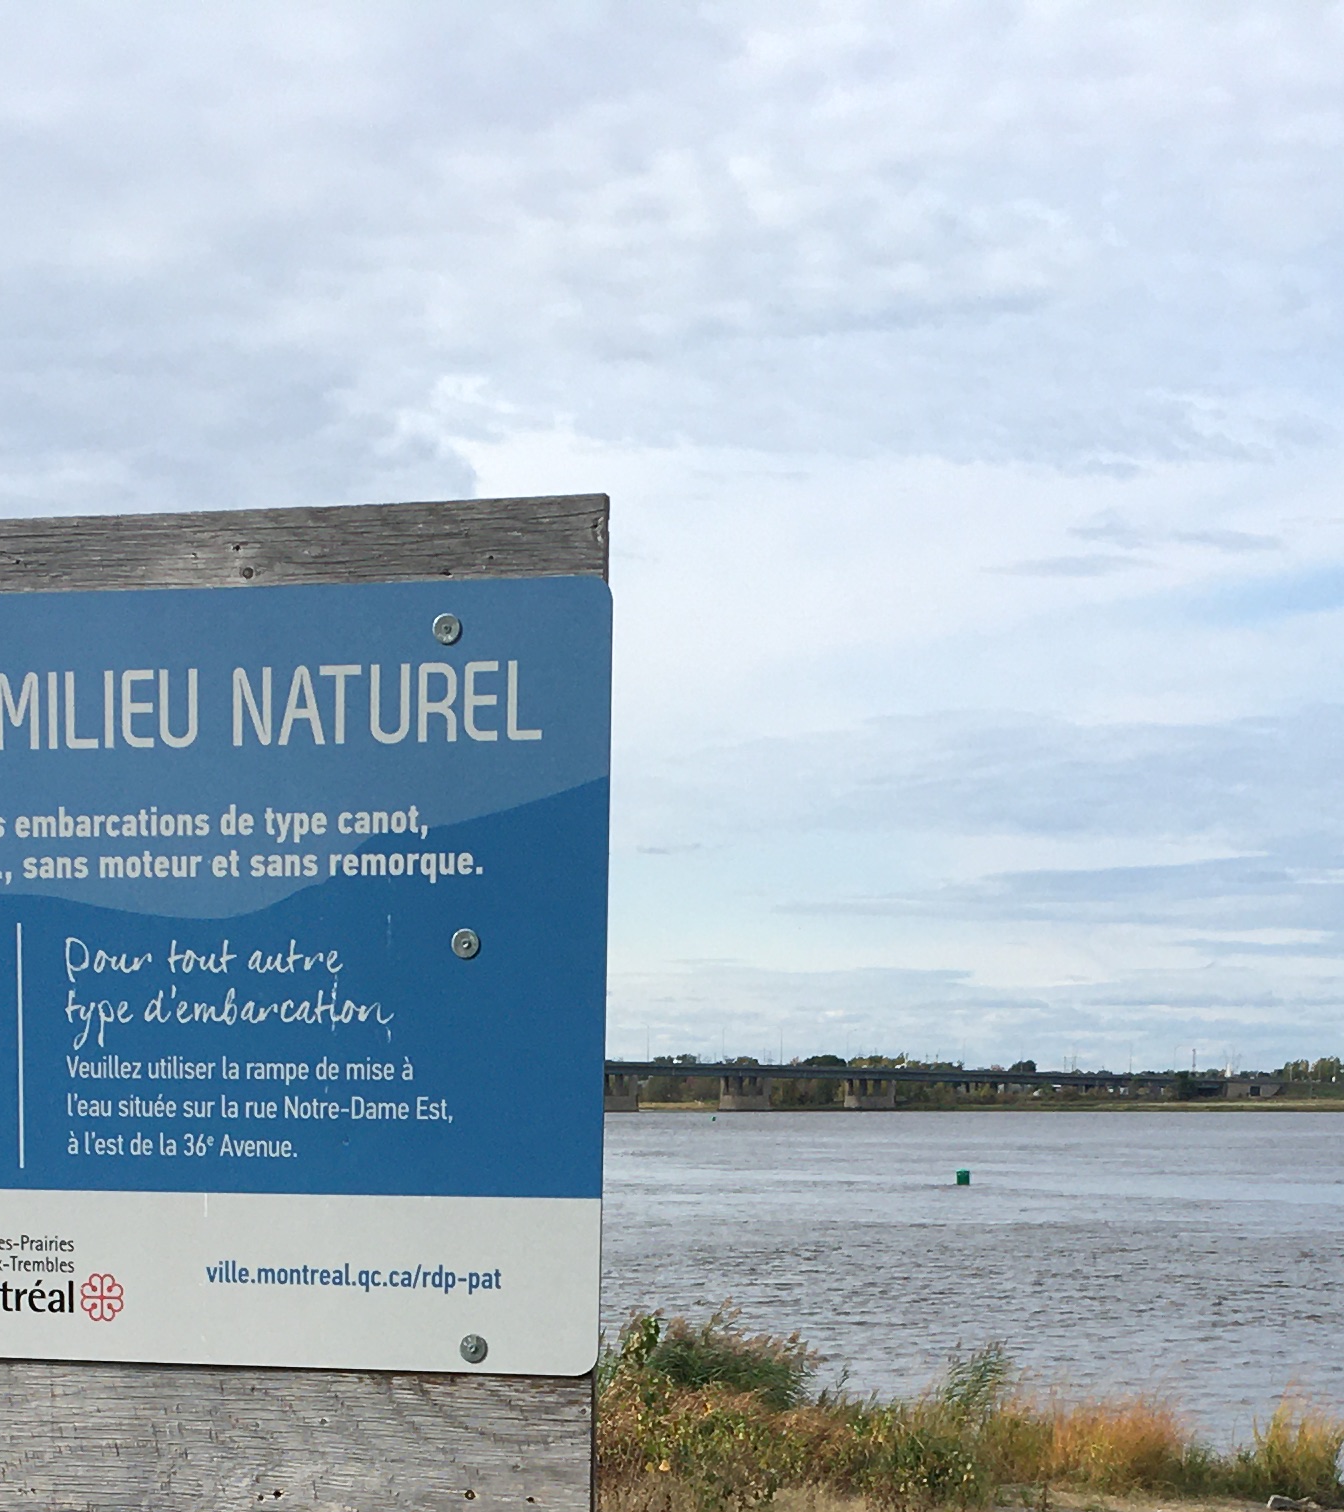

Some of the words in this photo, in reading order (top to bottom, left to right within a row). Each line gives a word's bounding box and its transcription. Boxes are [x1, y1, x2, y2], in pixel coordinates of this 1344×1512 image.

[232, 660, 543, 747] NATUREL
[15, 806, 210, 837] embarcations
[220, 804, 253, 836] de
[265, 806, 327, 843] type
[337, 804, 428, 840] canot,
[23, 854, 88, 879] sans
[99, 851, 203, 878] moteur
[211, 851, 240, 877] et
[250, 853, 318, 877] sans
[328, 850, 484, 884] remorque.
[64, 937, 152, 984] Pour
[167, 939, 237, 974] tout
[248, 939, 343, 974] autre
[64, 990, 133, 1050] type
[66, 1055, 141, 1080] Veuillez
[147, 1056, 216, 1080] utiliser
[222, 1056, 240, 1080] la
[246, 1061, 309, 1086] rampe
[315, 1057, 340, 1081] de
[346, 1058, 394, 1081] mise
[401, 1058, 414, 1081] à
[66, 1093, 112, 1118] l'eau
[118, 1094, 176, 1118] située
[183, 1100, 215, 1119] sur
[221, 1095, 239, 1119] la
[245, 1101, 277, 1119] rue
[283, 1096, 409, 1121] Notre-Dame
[416, 1097, 454, 1124] Est,
[67, 1130, 79, 1155] à
[84, 1132, 124, 1155] l'est
[130, 1132, 154, 1156] de
[159, 1133, 177, 1156] la
[220, 1134, 298, 1158] Avenue.
[206, 1260, 502, 1295] ville.montreal.qc.ca/rdp-pat
